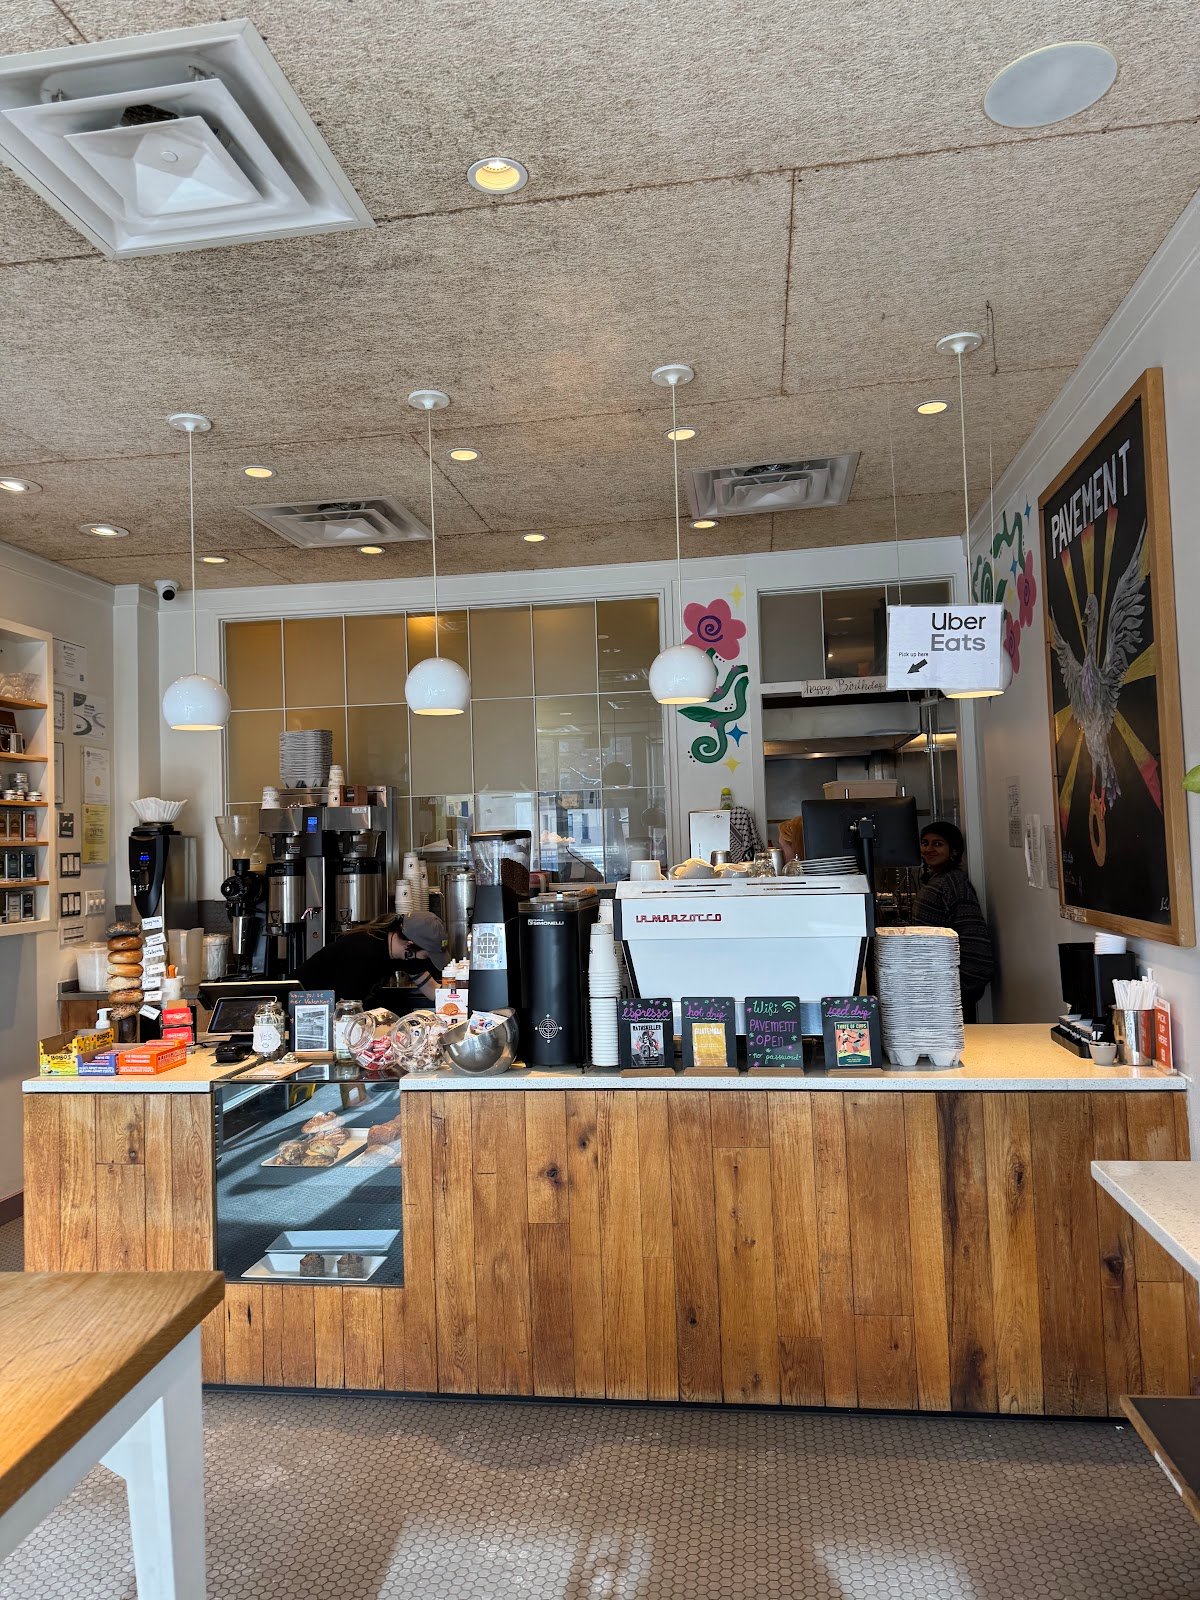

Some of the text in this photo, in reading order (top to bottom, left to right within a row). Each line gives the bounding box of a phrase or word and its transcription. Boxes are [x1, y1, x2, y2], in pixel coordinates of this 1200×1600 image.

[1051, 439, 1130, 560] PAVEMENT
[932, 612, 987, 631] Uber
[931, 633, 986, 652] Eats
[635, 913, 722, 923] LA MARZOCCO
[622, 1007, 672, 1021] espresso
[686, 1005, 727, 1021] hot drip
[752, 1000, 779, 1016] Wifi
[827, 1003, 871, 1019] iced drip
[749, 1019, 798, 1033] PAVEMENT
[755, 1035, 784, 1048] OPEN
